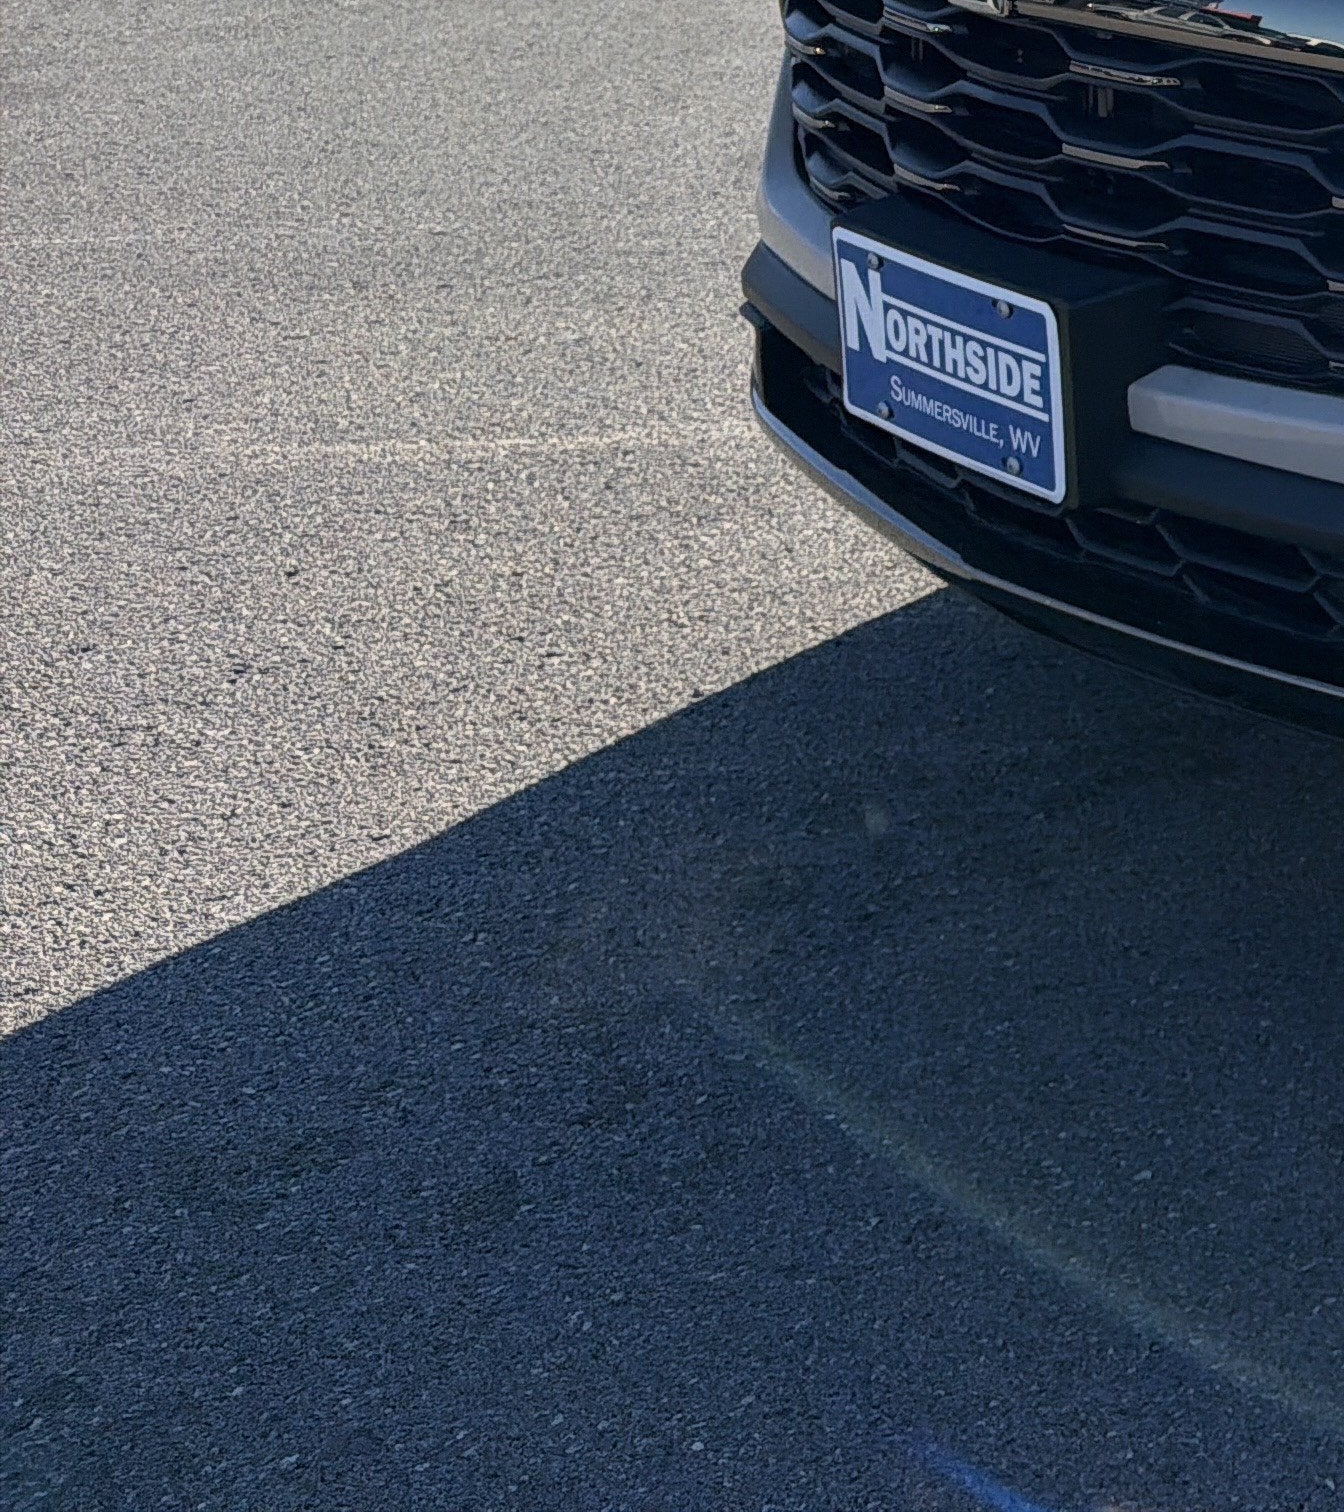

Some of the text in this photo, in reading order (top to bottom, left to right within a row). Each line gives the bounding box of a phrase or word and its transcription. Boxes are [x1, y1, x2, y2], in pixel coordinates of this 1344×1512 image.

[840, 257, 1044, 409] NORTHSIDE
[890, 374, 1041, 458] SUMMERSVILLE, WV
